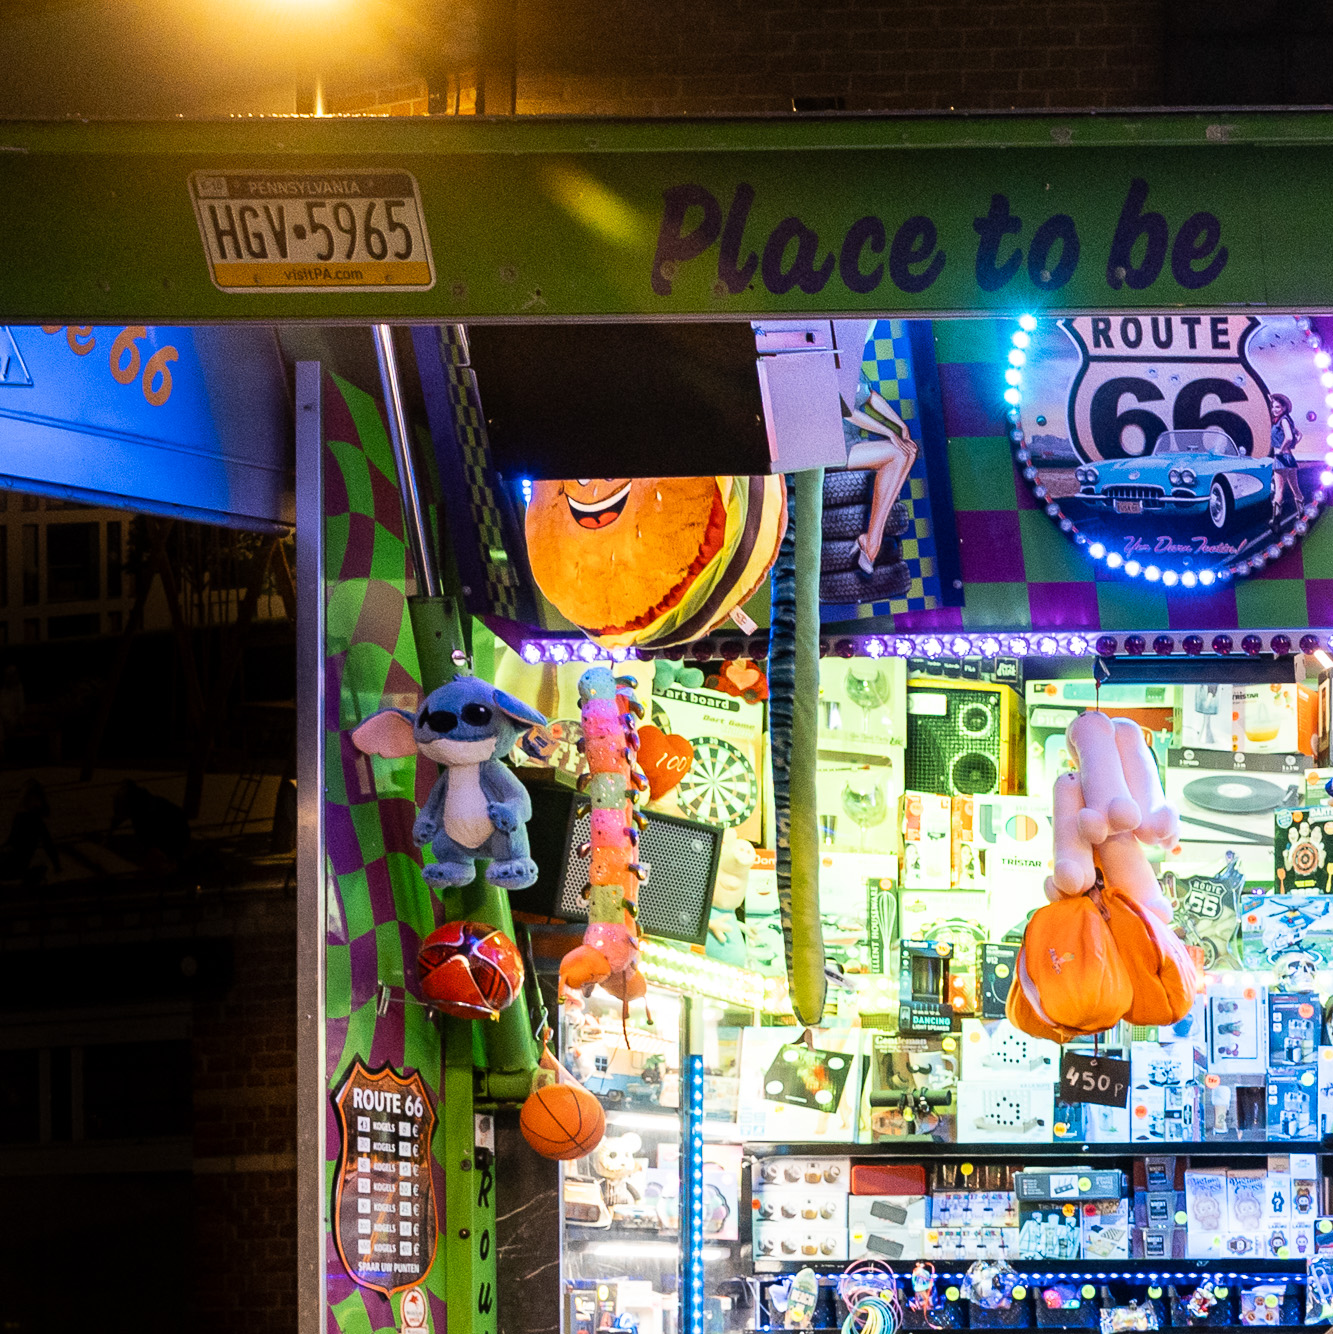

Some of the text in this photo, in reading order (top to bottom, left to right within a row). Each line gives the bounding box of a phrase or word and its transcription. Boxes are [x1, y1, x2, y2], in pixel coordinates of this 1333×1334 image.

[250, 180, 361, 196] PENNSYLVANIA
[651, 177, 1230, 297] Place to be
[284, 267, 363, 282] visitPA.com
[1091, 316, 1232, 350] ROUTE
[1090, 376, 1254, 460] 66
[690, 693, 730, 710] board
[1193, 881, 1225, 897] ROUTE
[912, 1016, 951, 1025] DANCING
[353, 1087, 423, 1118] ROUTE 66
